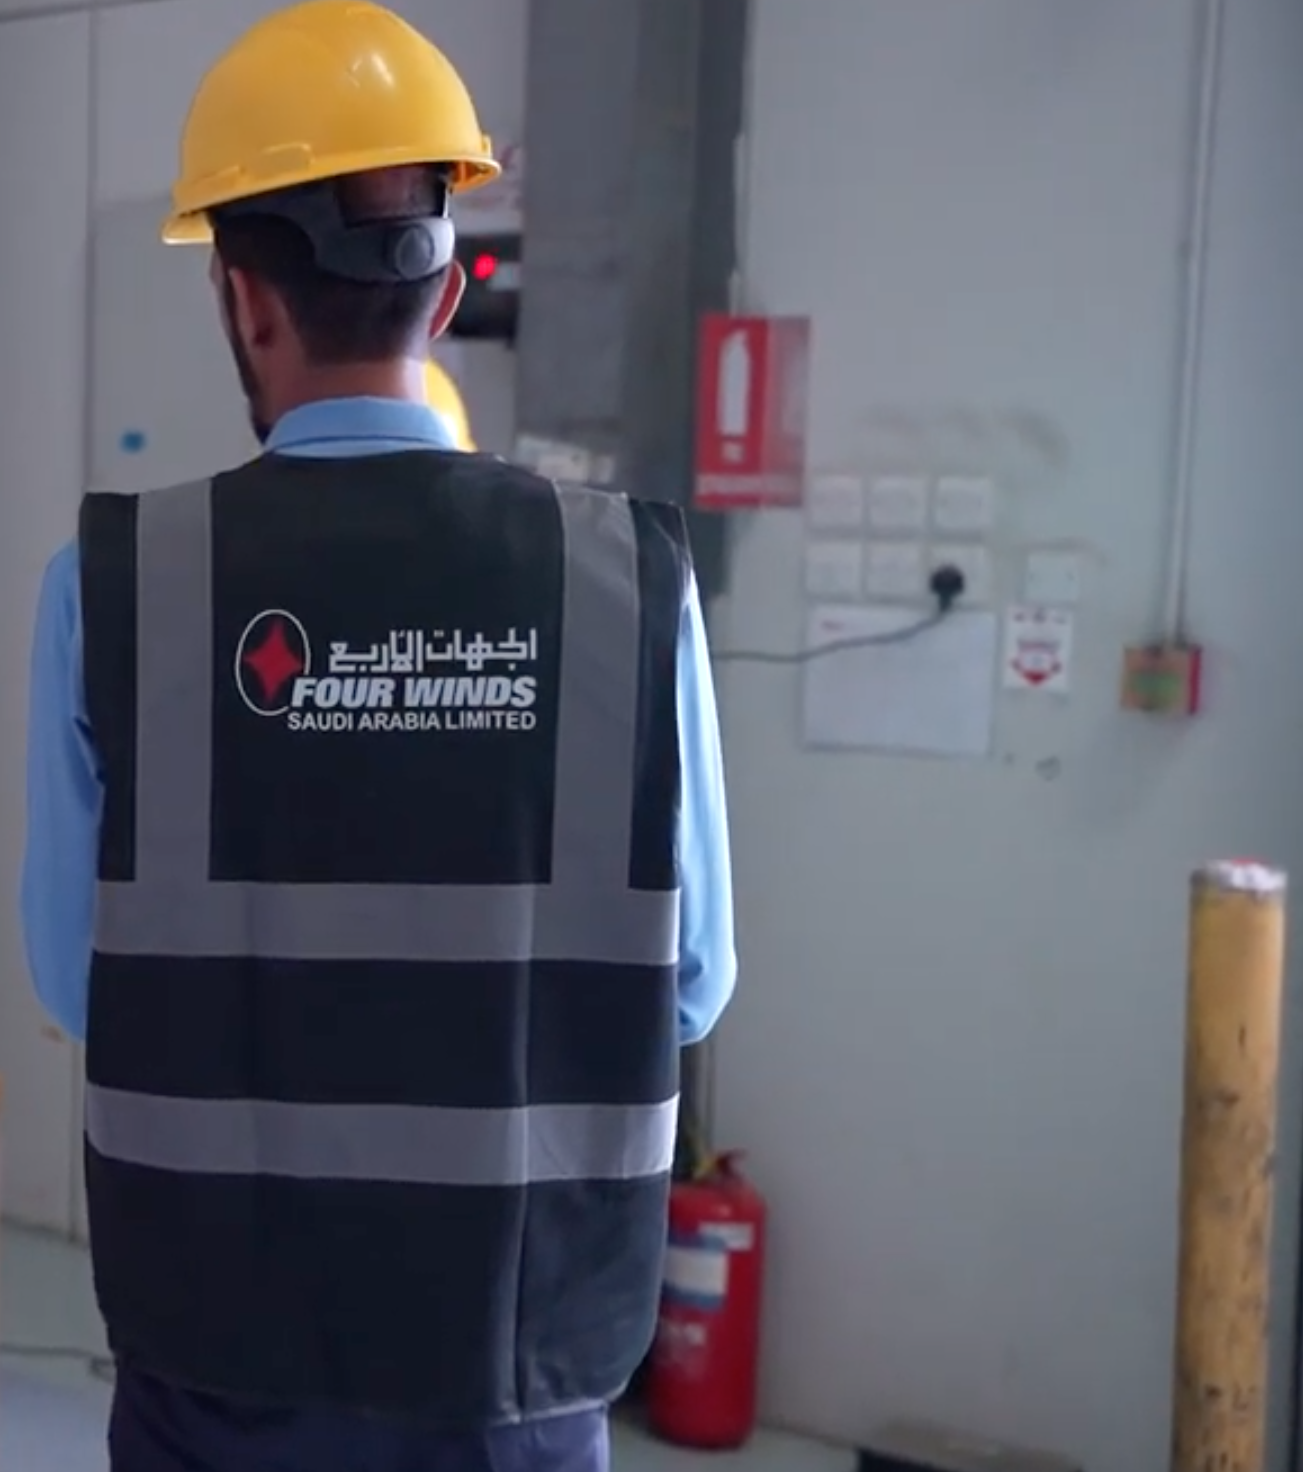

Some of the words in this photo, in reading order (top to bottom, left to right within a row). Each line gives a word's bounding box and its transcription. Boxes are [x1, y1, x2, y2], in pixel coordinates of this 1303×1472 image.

[291, 677, 396, 708] FOUR
[404, 676, 538, 708] WINDS
[287, 712, 353, 731] SAUDI
[357, 712, 441, 731] ARABIA
[446, 710, 537, 730] LIMITED
